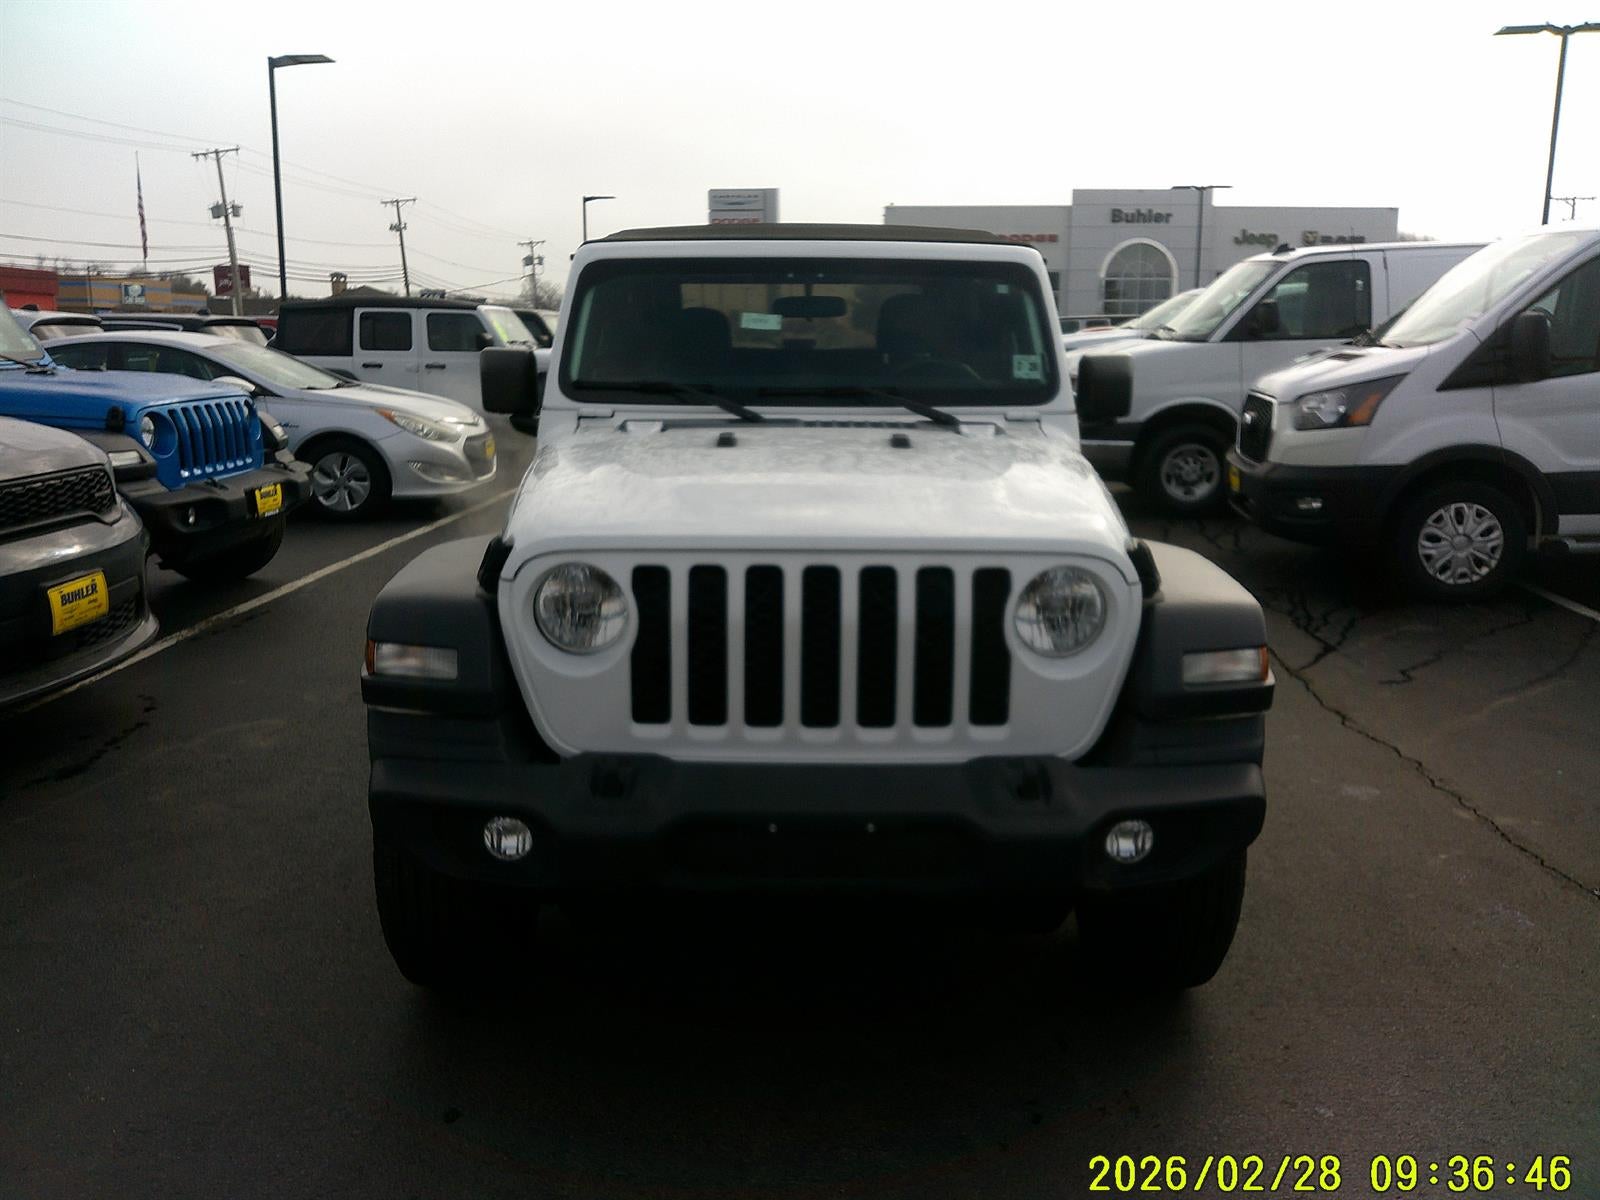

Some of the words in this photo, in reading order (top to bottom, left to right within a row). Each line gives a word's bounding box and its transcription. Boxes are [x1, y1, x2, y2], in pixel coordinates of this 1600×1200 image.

[1111, 207, 1174, 224] Buhler
[1233, 228, 1279, 248] Jeep
[60, 583, 98, 607] BUHLER
